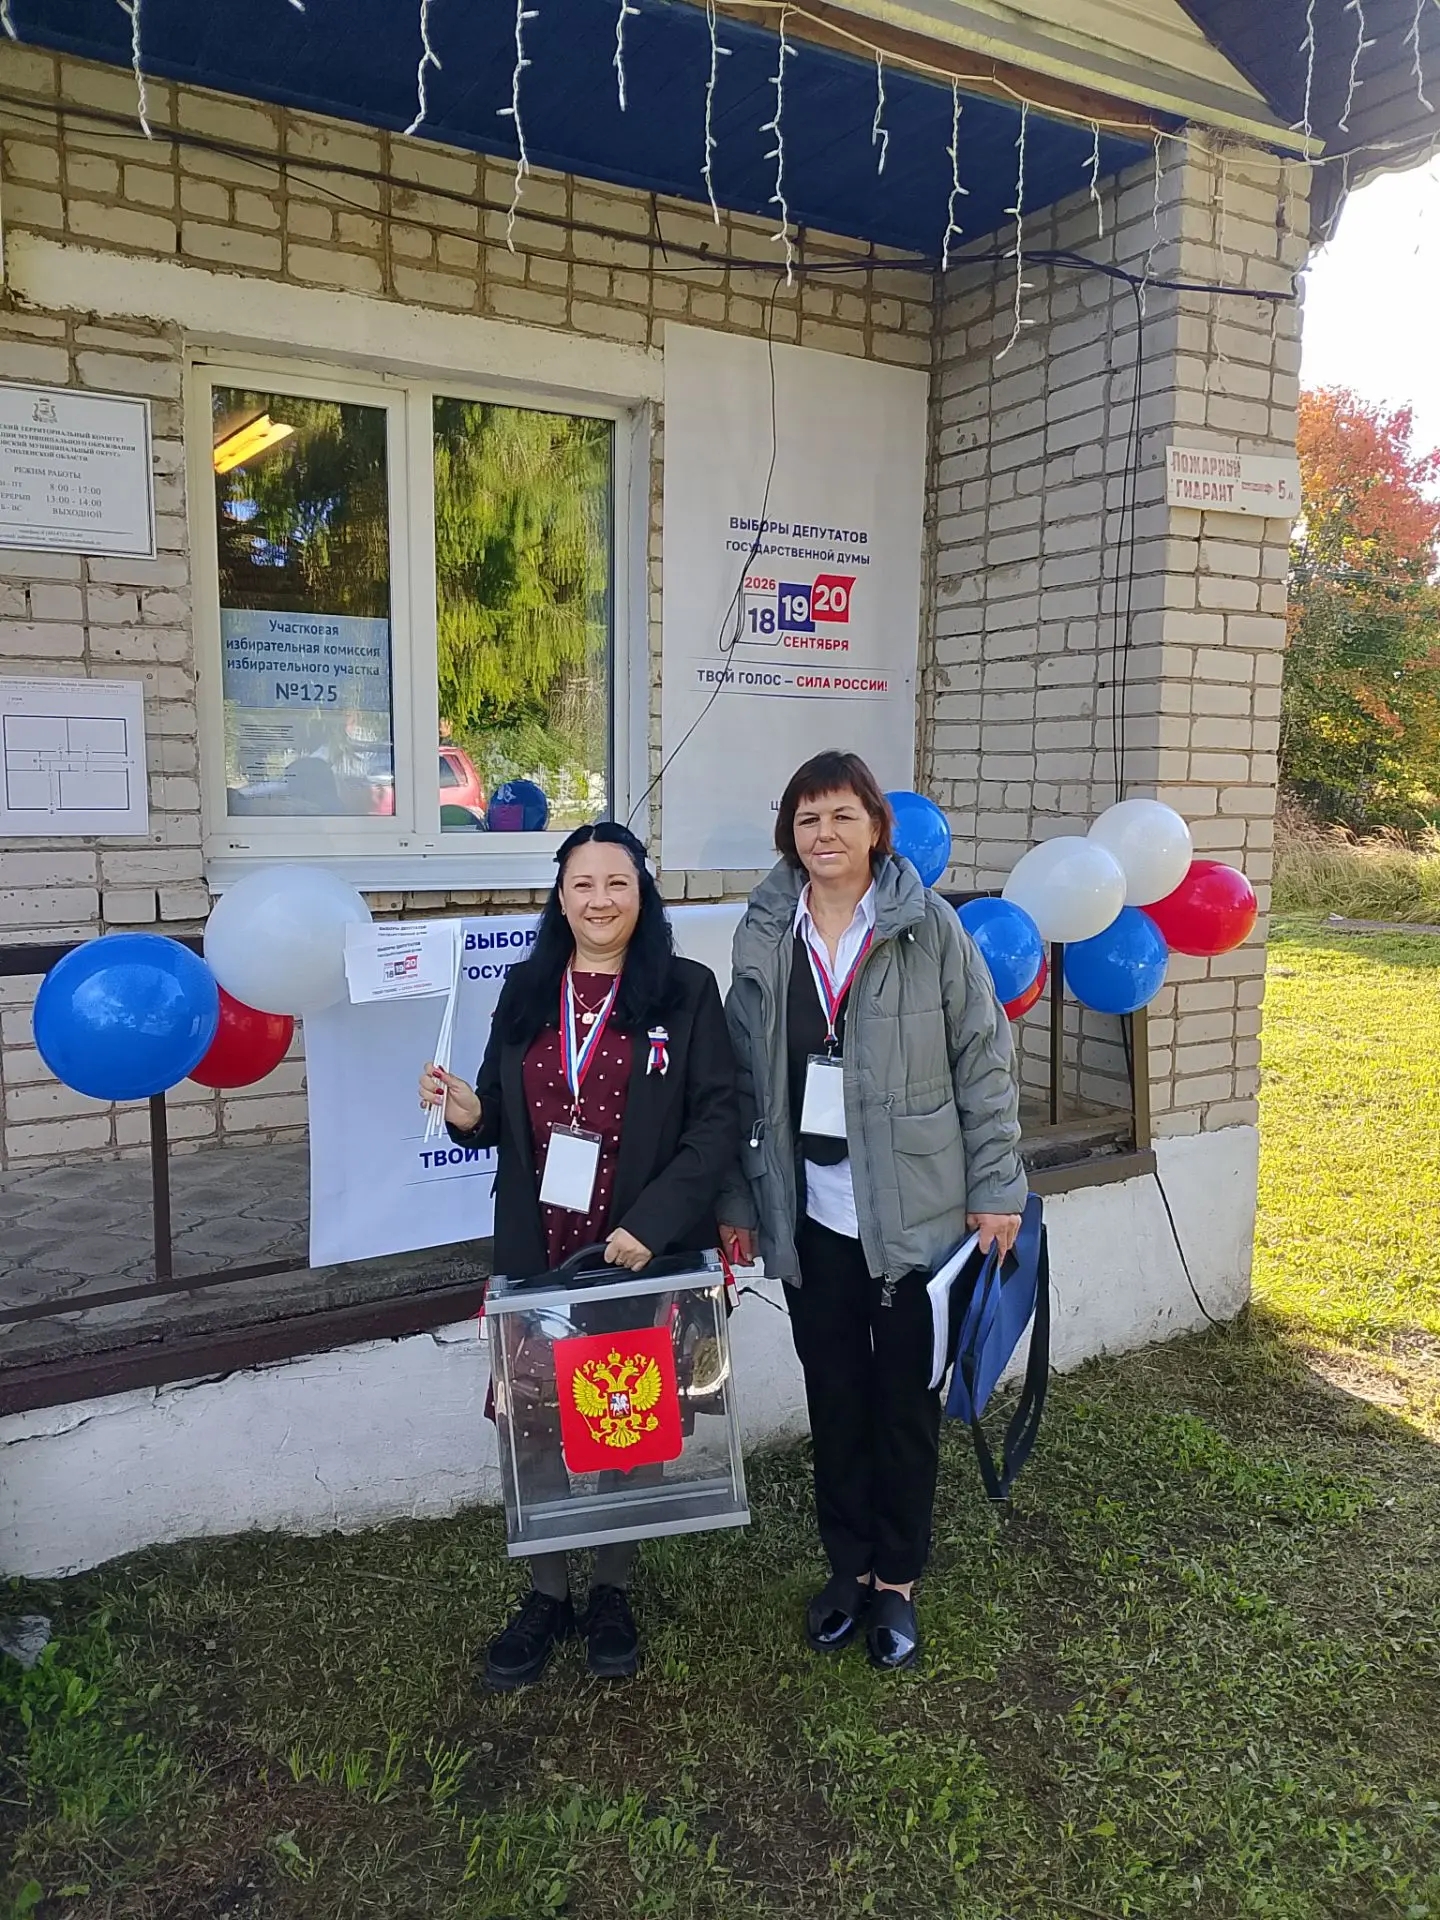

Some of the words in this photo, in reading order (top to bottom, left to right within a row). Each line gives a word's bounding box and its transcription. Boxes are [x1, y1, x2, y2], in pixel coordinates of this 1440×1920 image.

[92, 433, 124, 443] КОМИТЕТ
[14, 466, 46, 476] РЕЖИМ
[48, 469, 81, 479] РАБОТЫ
[1172, 451, 1241, 478] ПОЖАРНЫЙ
[78, 486, 102, 496] 17:00
[46, 495, 70, 505] 13:00
[79, 498, 102, 508] 14:00
[52, 507, 102, 519] ВЫХОДНОЙ
[730, 517, 789, 535] ВЫБОРЫ
[792, 524, 868, 544] ДЕПУТАТОВ
[837, 552, 870, 565] ДУМЫ
[744, 577, 776, 590] 2026
[747, 607, 775, 634] 18
[781, 595, 809, 622] 19
[814, 585, 847, 612] 20
[269, 619, 339, 636] Участковая
[226, 637, 320, 655] избирательная
[323, 644, 380, 657] комиссия
[783, 636, 849, 651] СЕНТЯБРЯ
[227, 656, 330, 673] избирательного
[333, 664, 380, 677] участка
[697, 668, 735, 684] ТВОЙ
[739, 673, 781, 686] ГОЛОС
[796, 676, 830, 689] СИЛА
[834, 679, 888, 692] РОССИИ!
[275, 682, 337, 702] №125
[464, 930, 537, 950] ВЫБОР
